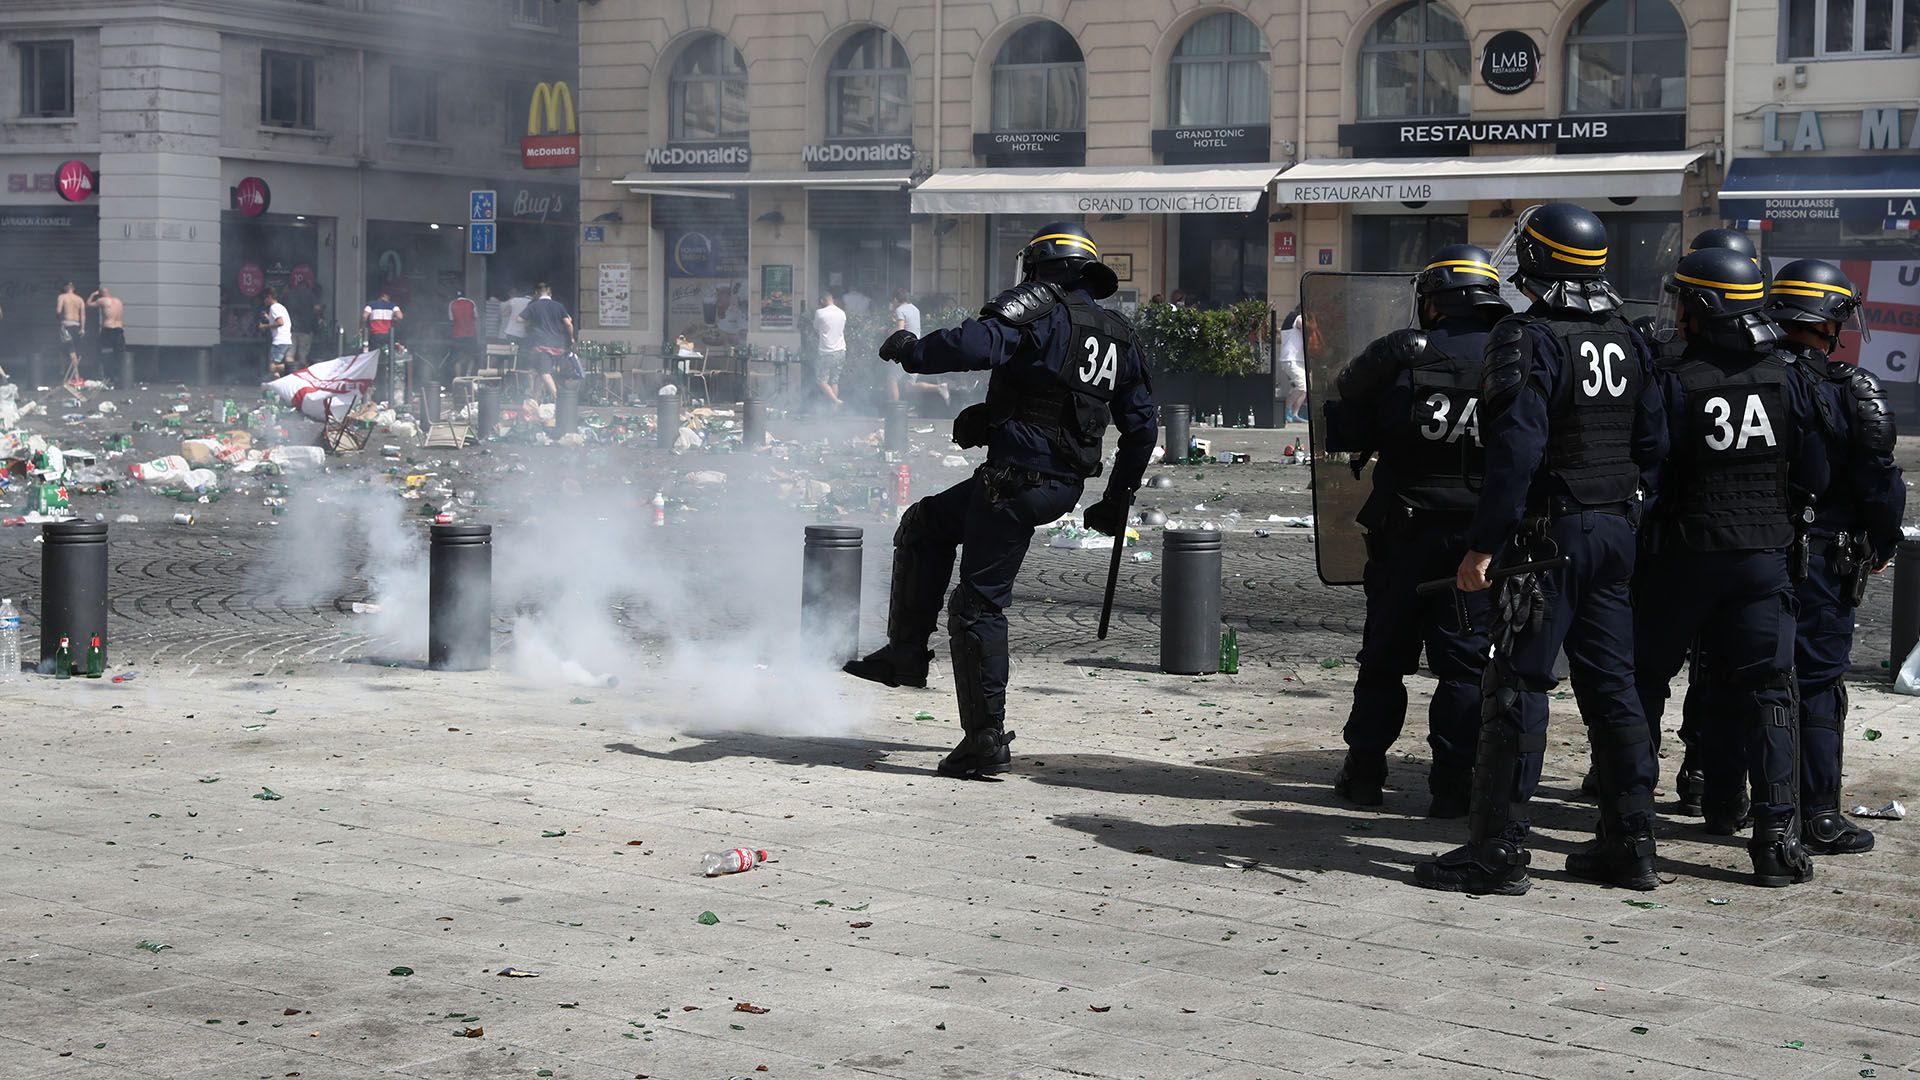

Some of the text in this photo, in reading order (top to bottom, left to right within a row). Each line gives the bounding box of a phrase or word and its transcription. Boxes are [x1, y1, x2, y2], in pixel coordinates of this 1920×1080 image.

[1492, 51, 1529, 68] LMB
[995, 133, 1061, 142] GRAND TONIC
[1175, 128, 1245, 139] GRAND TONIC
[1400, 122, 1608, 142] RESTAURANT LMB
[1763, 110, 1825, 151] LA
[526, 146, 576, 157] McDonald's
[1012, 143, 1044, 151] HOTEL
[1193, 139, 1227, 147] HOTEL
[645, 147, 748, 165] McDonald's
[801, 143, 911, 161] McDonald's
[1294, 184, 1432, 201] RESTAURANT LMB
[513, 190, 562, 224] Bug's
[1078, 193, 1242, 211] GRAND TONIC HÔTEL
[1765, 199, 1917, 216] BOUILLABAISSE LA
[1765, 207, 1840, 219] POISSON GRILLÉ
[1283, 236, 1293, 246] H
[1079, 335, 1118, 391] 3A
[1580, 340, 1628, 398] 3C
[1420, 392, 1485, 448] 3A
[1704, 394, 1777, 451] 3A
